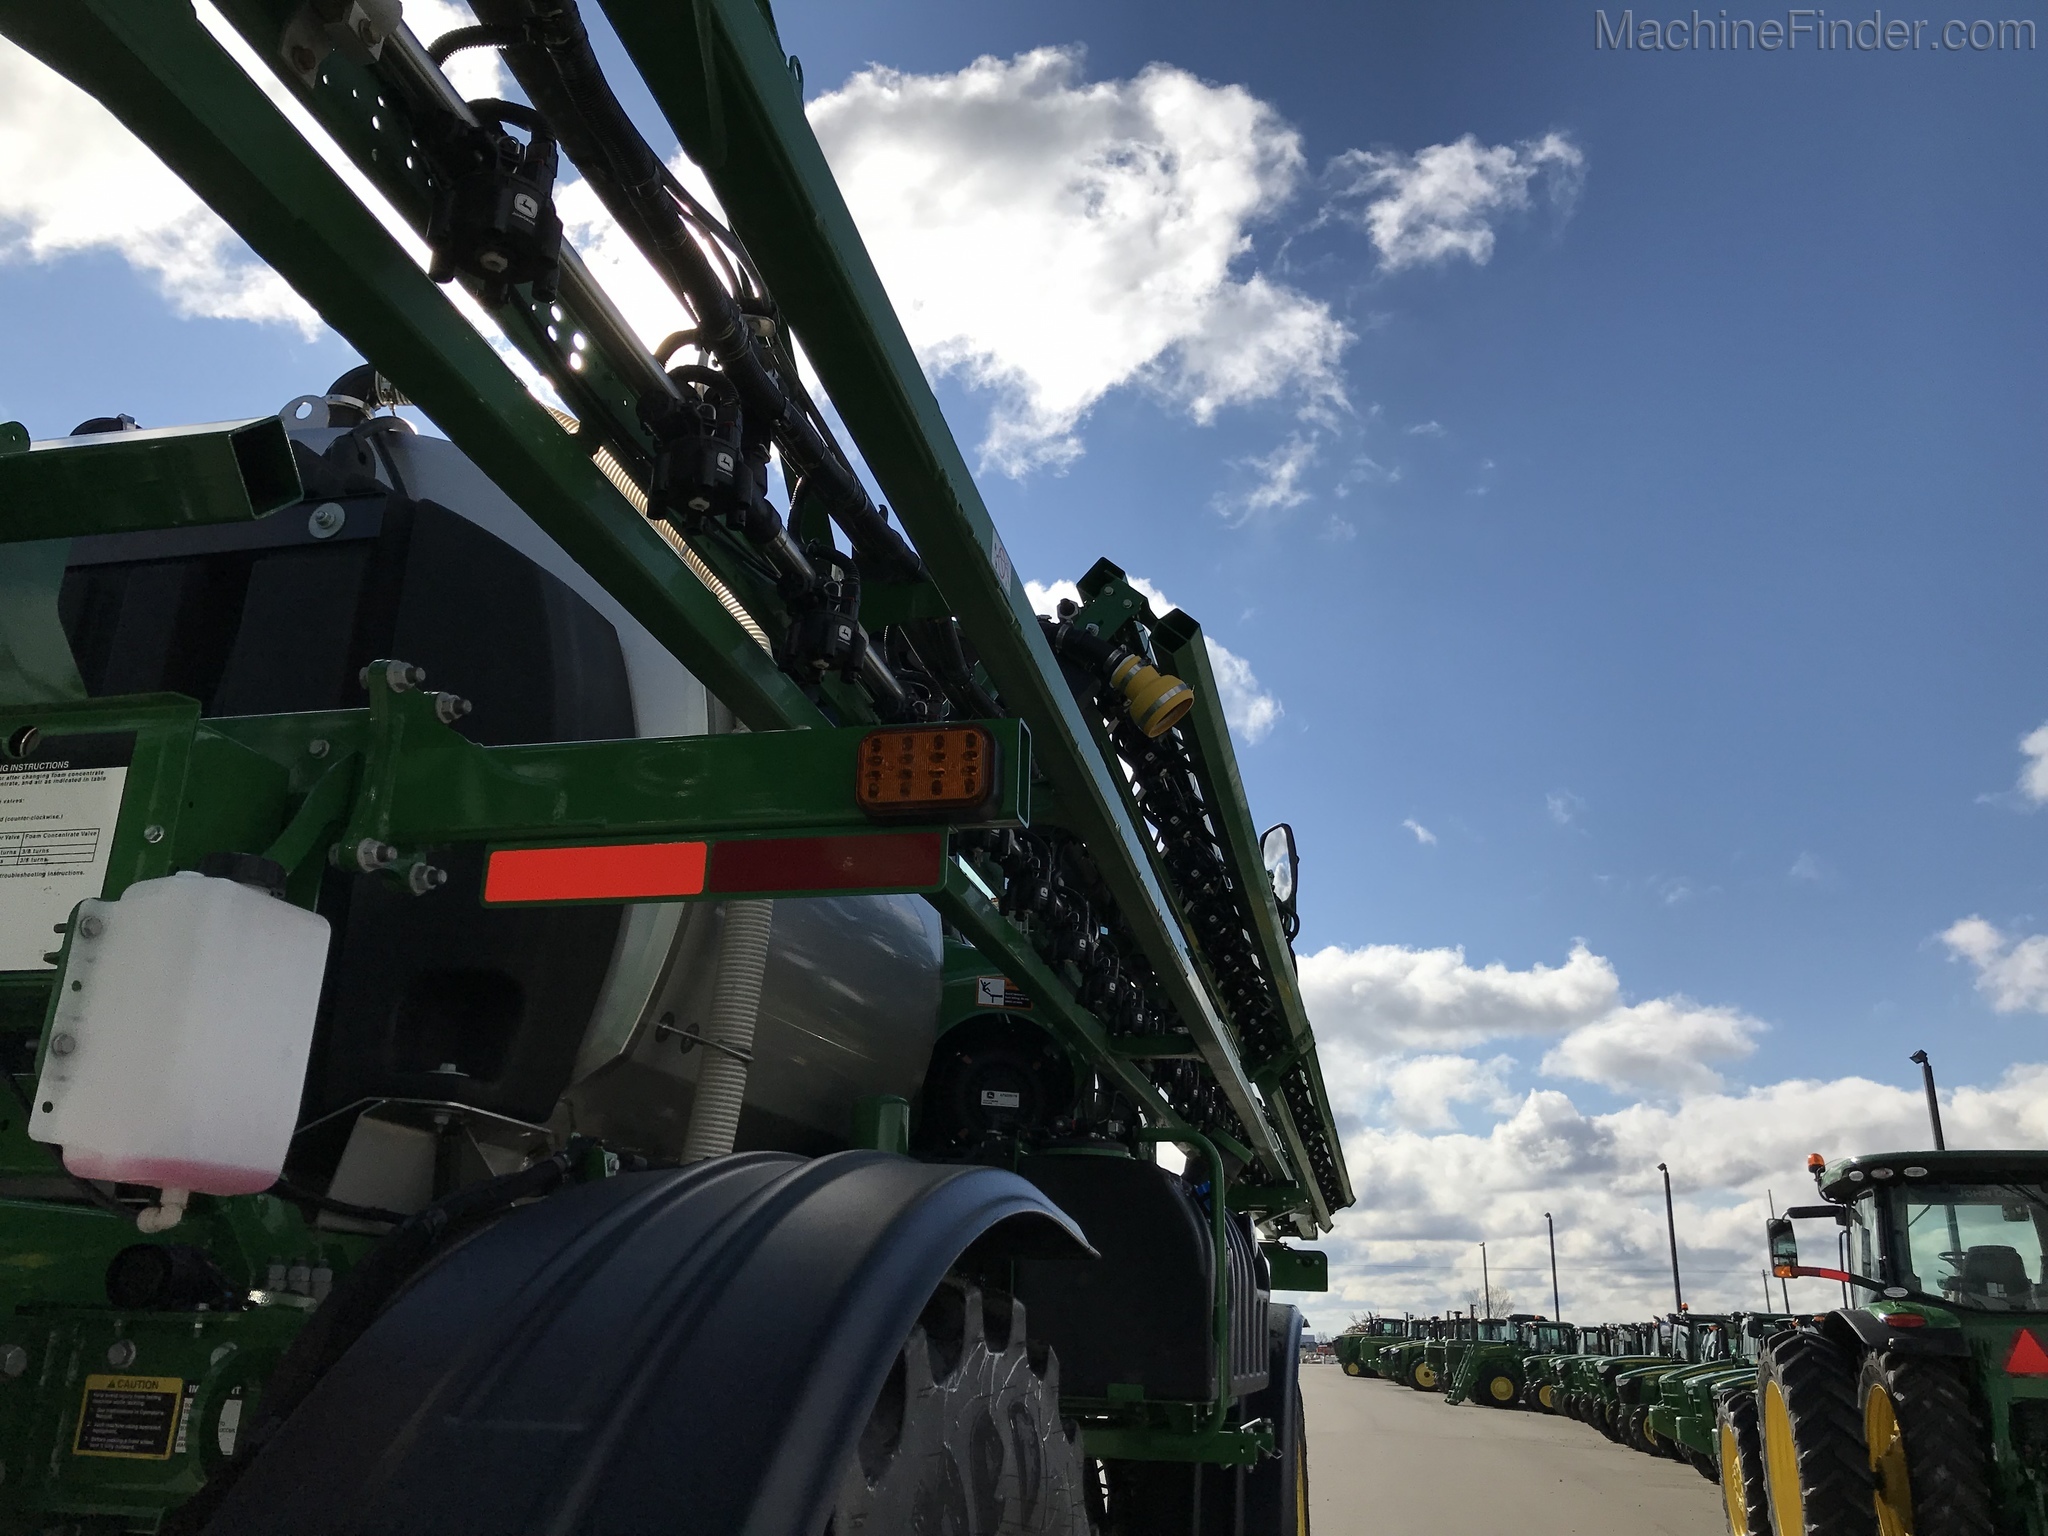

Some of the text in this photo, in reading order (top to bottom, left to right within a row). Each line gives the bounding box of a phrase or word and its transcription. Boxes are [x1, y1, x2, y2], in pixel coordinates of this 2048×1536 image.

[10, 761, 69, 771] INSTRUCTIONS
[43, 831, 79, 839] Concentrate
[117, 1380, 159, 1389] CAUTION
